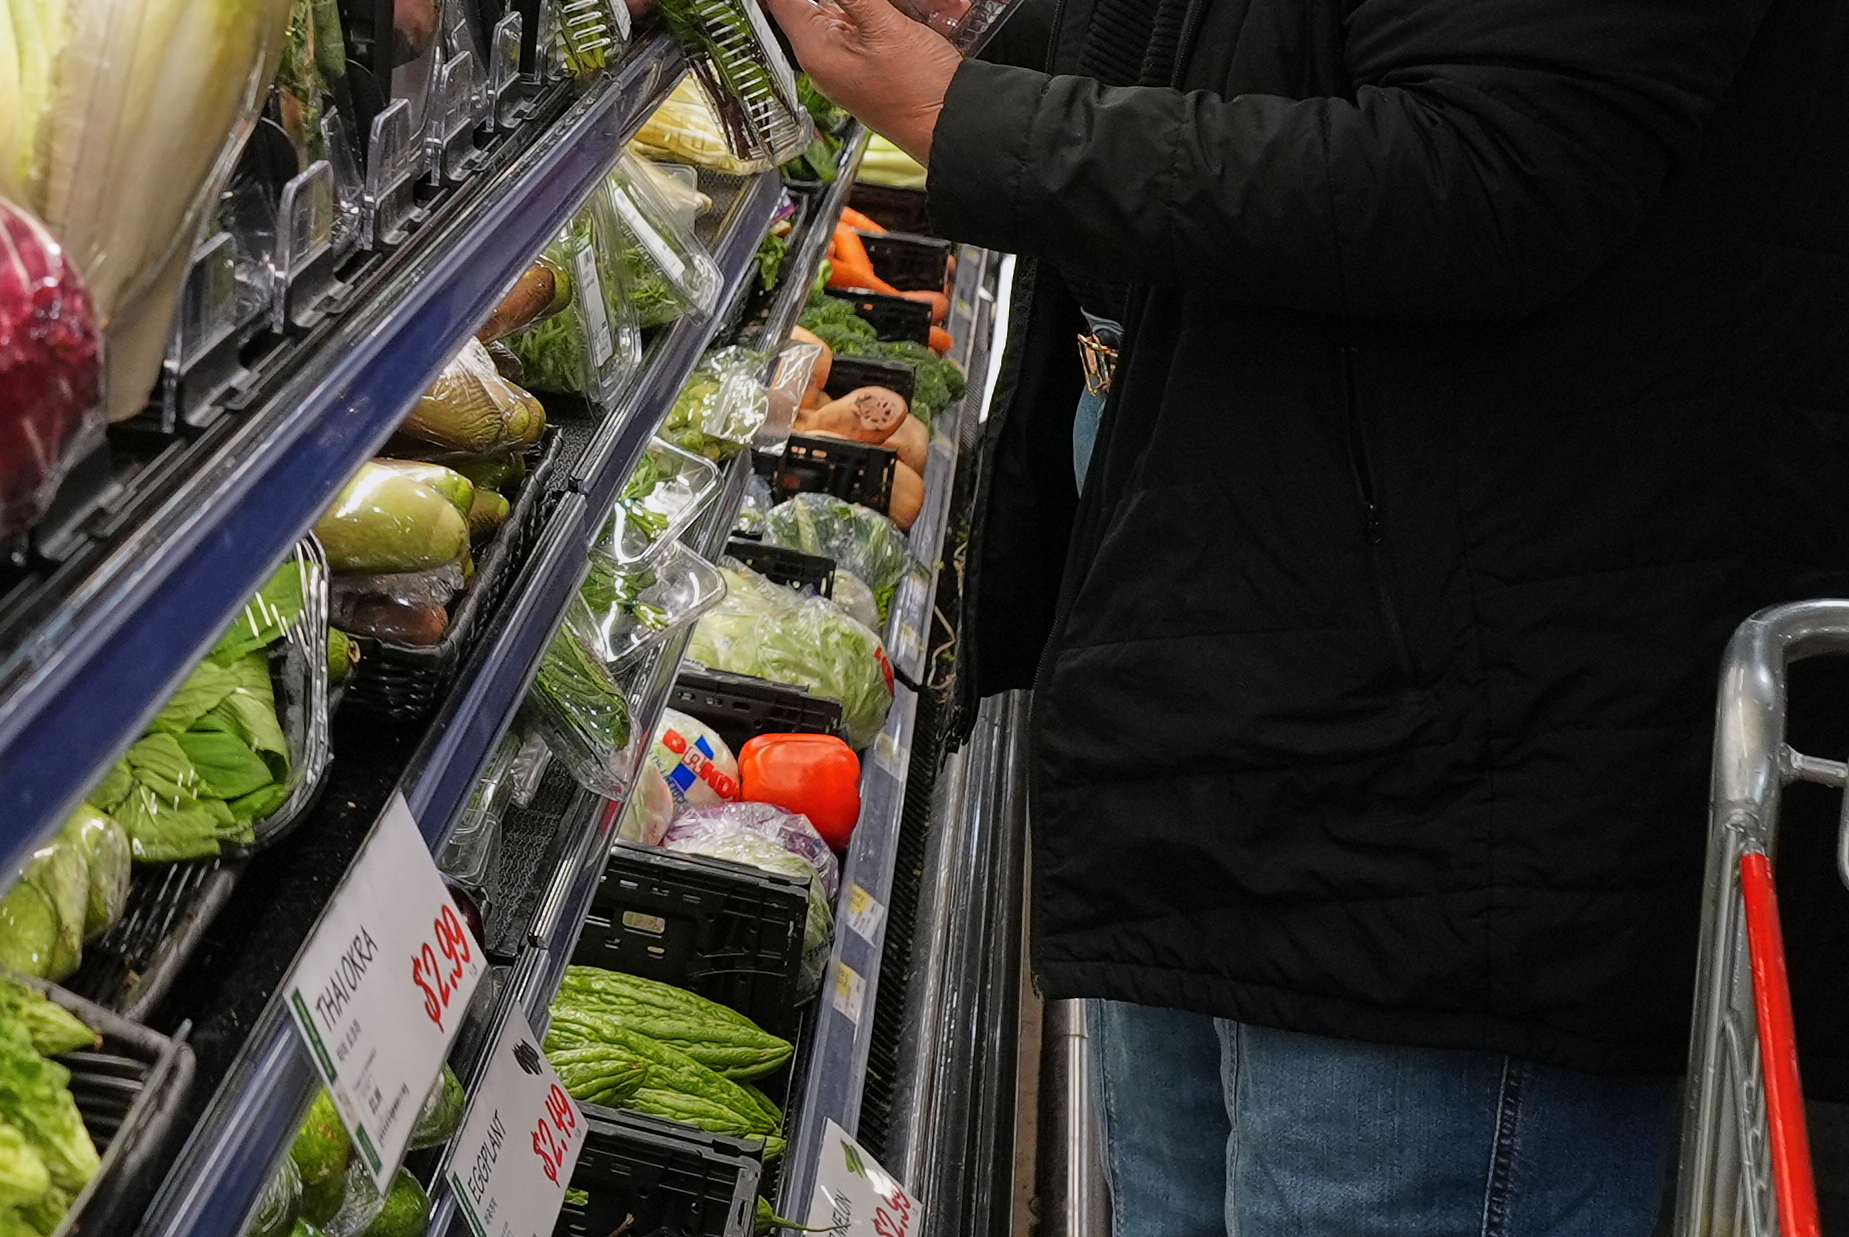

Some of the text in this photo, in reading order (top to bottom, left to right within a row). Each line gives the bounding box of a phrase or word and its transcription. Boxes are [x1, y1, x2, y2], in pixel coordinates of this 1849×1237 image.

[315, 969, 351, 1032] THAI
[341, 924, 379, 992] OKRA
[410, 904, 471, 1034] $2.99
[467, 1108, 507, 1206] EGGPLANT
[530, 1083, 576, 1188] $2.49
